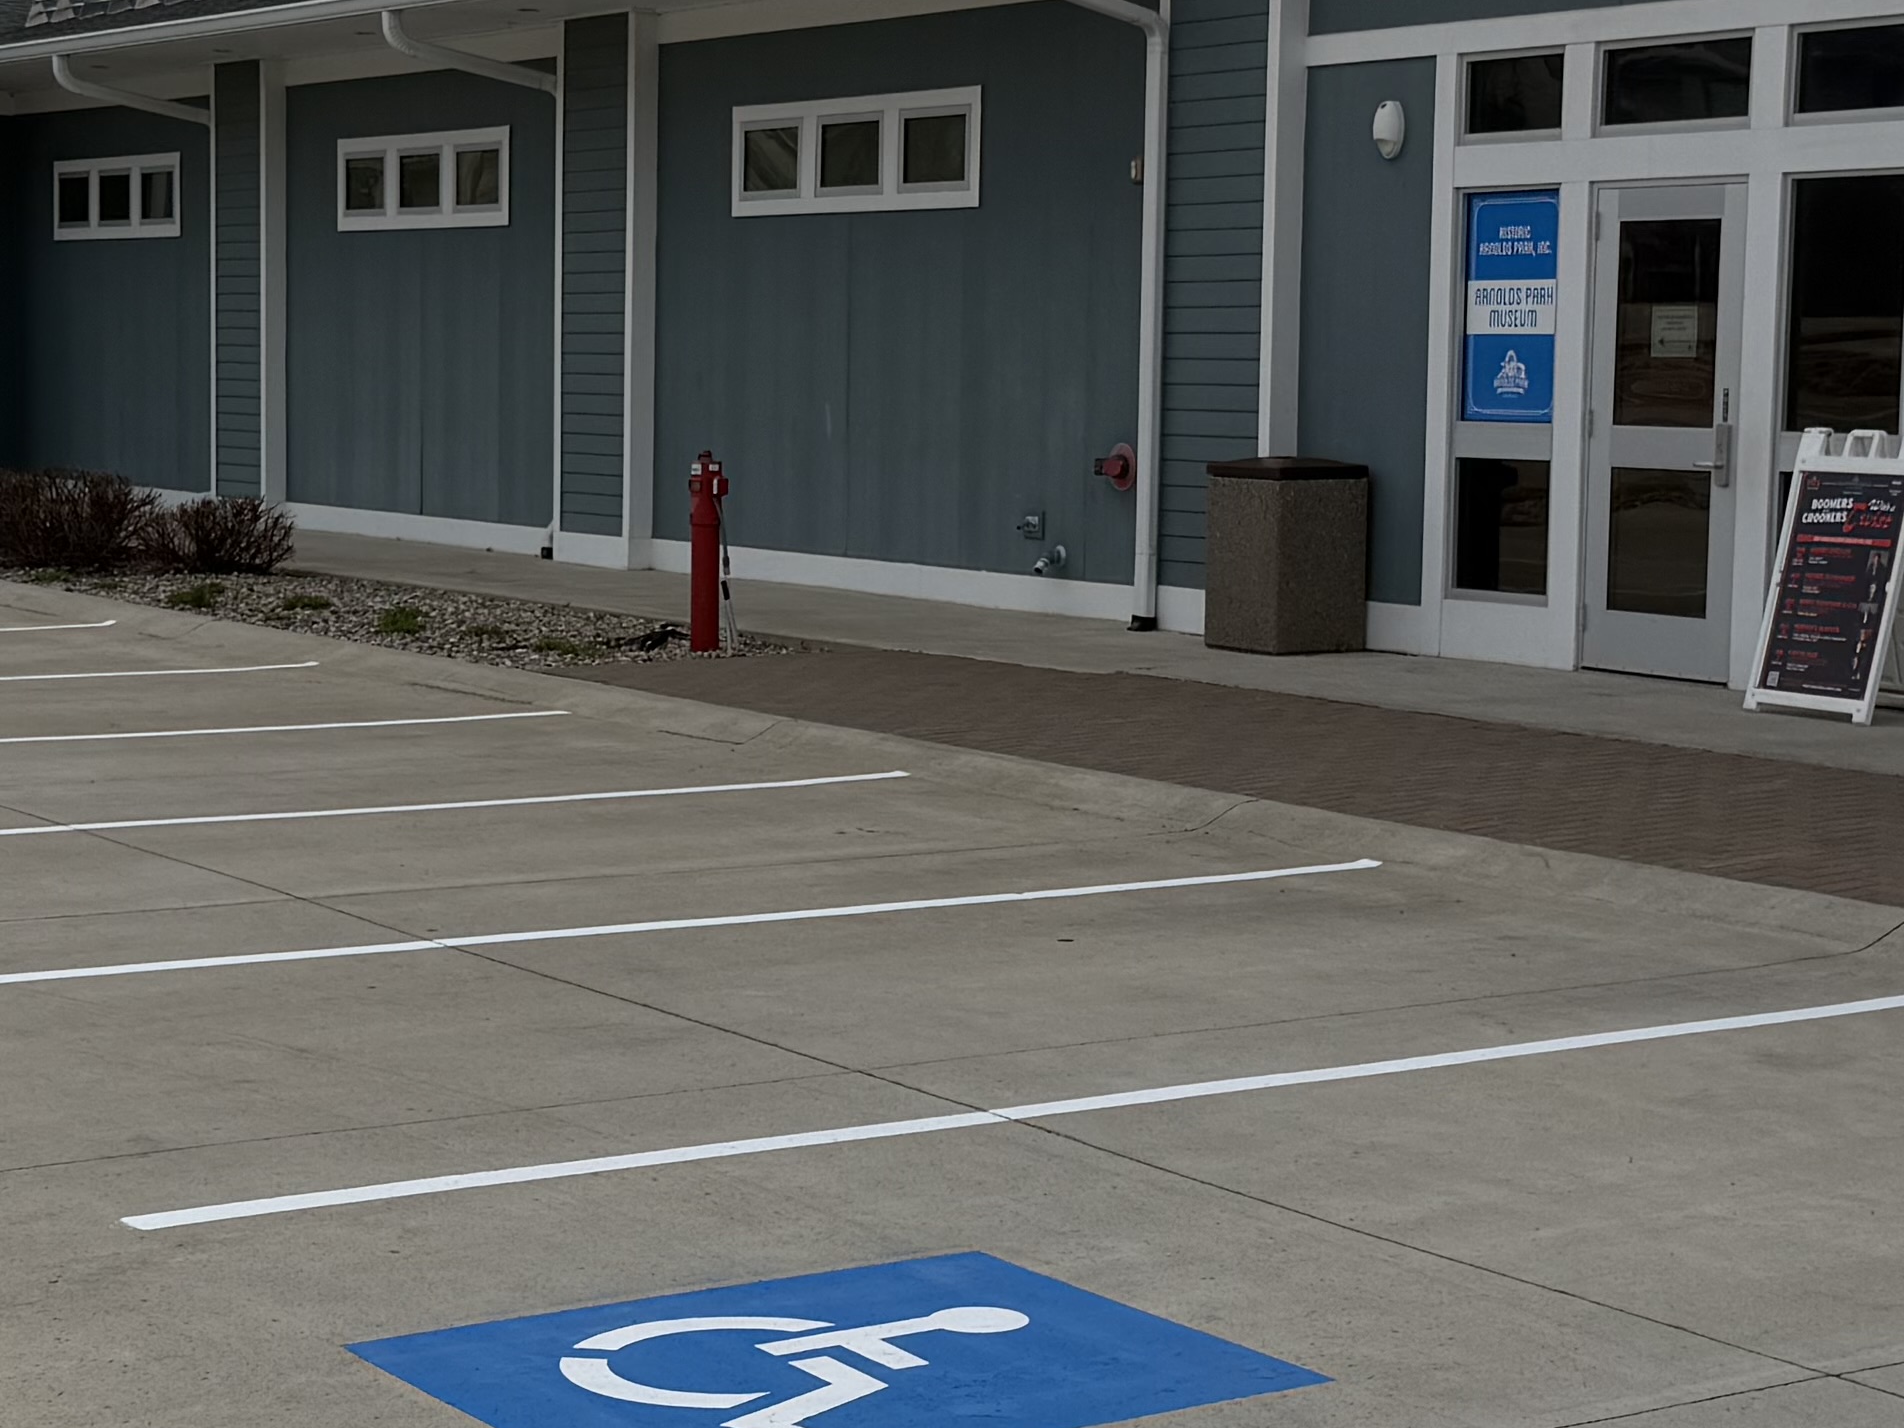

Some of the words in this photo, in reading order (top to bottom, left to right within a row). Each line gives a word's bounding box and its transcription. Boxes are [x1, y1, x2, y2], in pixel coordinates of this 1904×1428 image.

[1475, 287, 1522, 306] ARNOLDS
[1525, 286, 1554, 305] PARK
[1489, 309, 1537, 328] MUSEUM
[1811, 497, 1854, 511] BOOMERS
[1801, 511, 1848, 524] CROONERS
